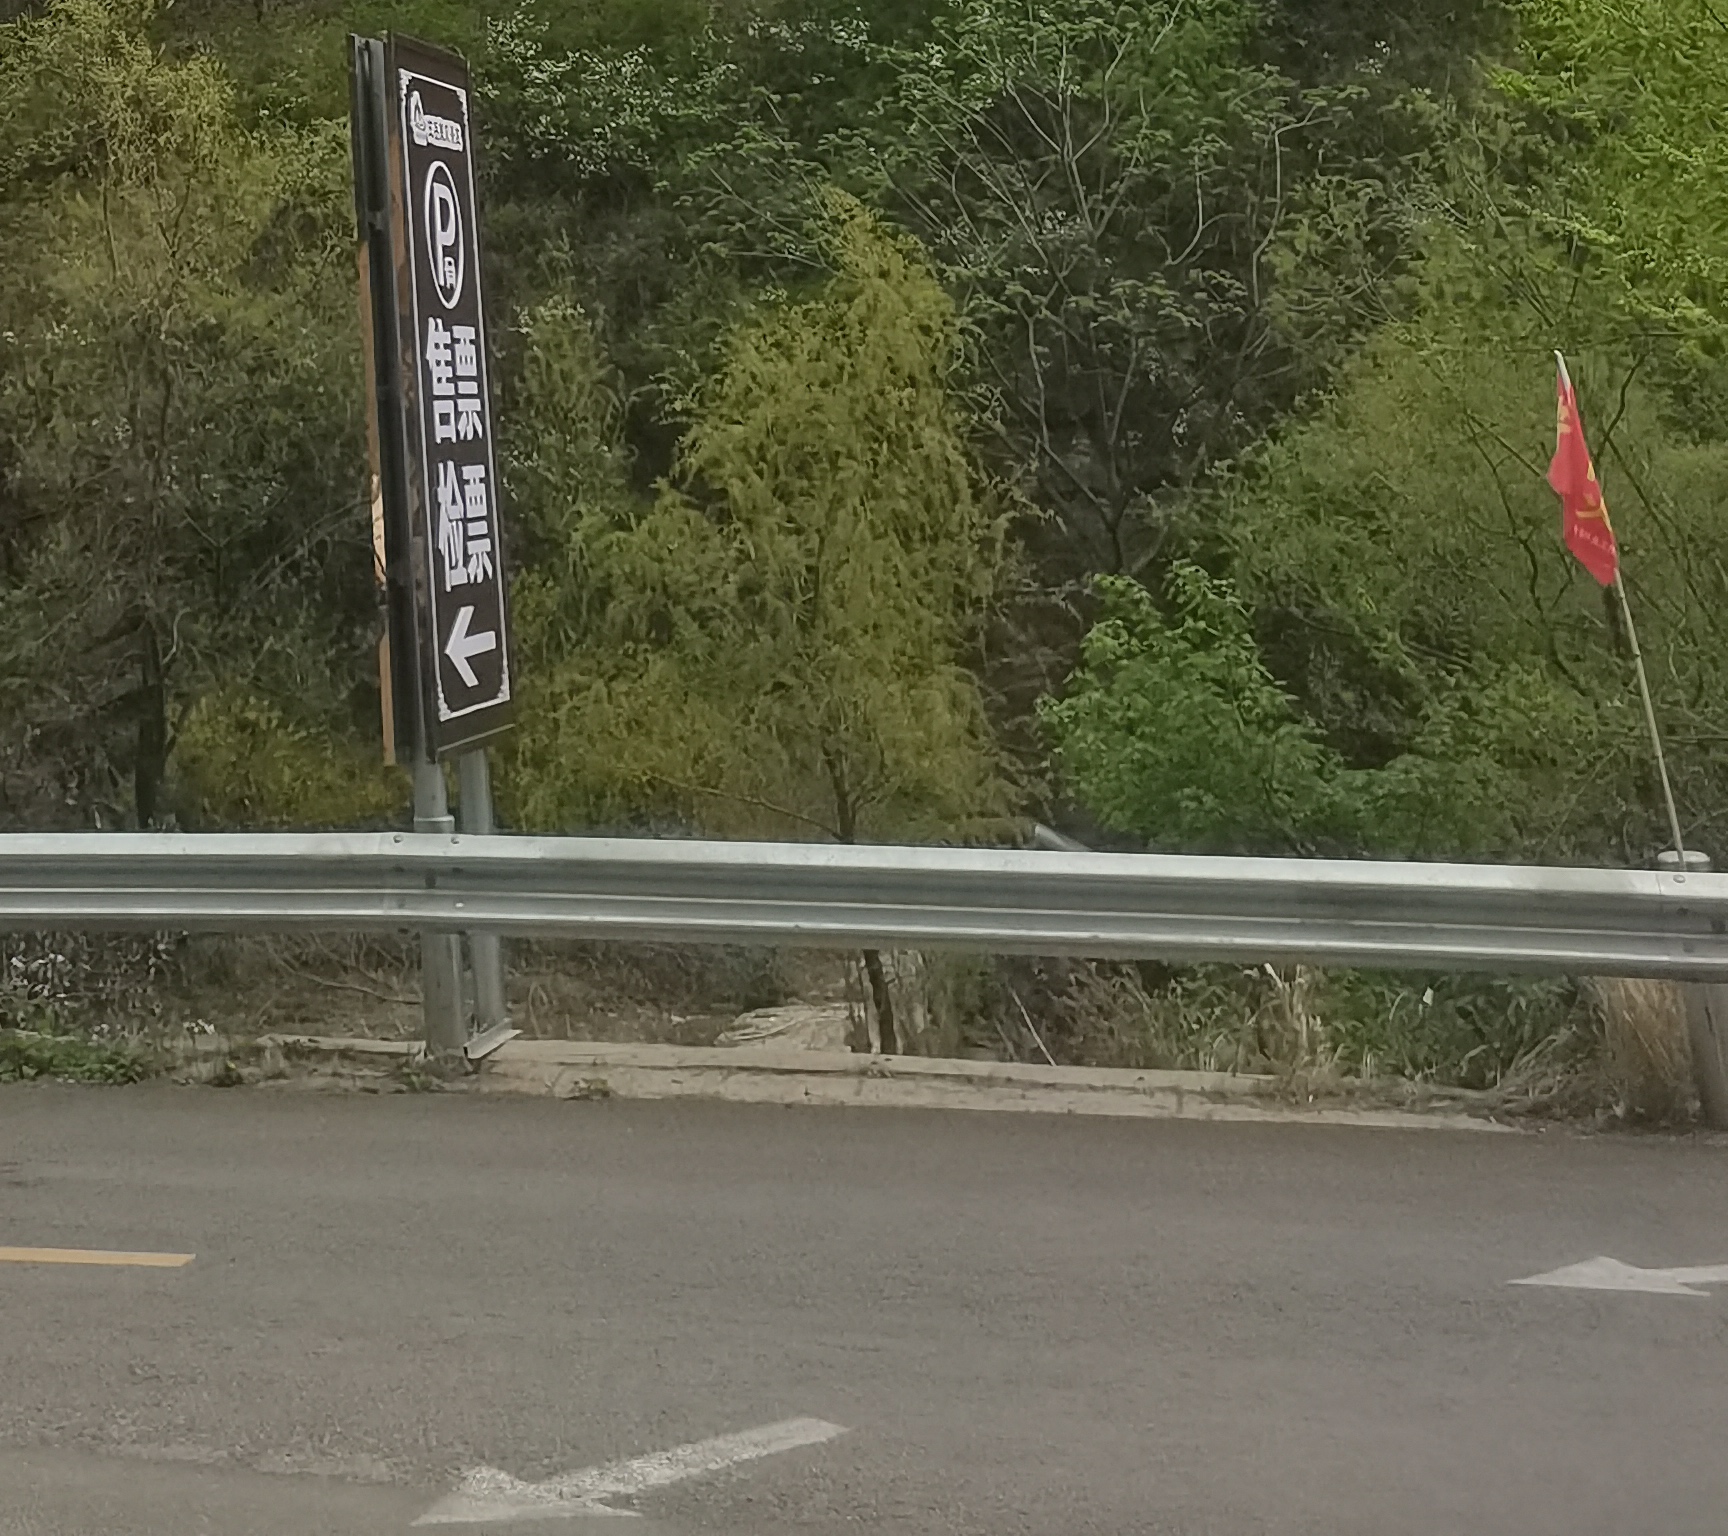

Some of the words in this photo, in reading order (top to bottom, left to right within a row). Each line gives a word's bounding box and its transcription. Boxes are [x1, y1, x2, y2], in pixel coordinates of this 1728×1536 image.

[432, 181, 456, 287] P
[425, 315, 483, 444] 售票
[437, 460, 493, 592] 检票
